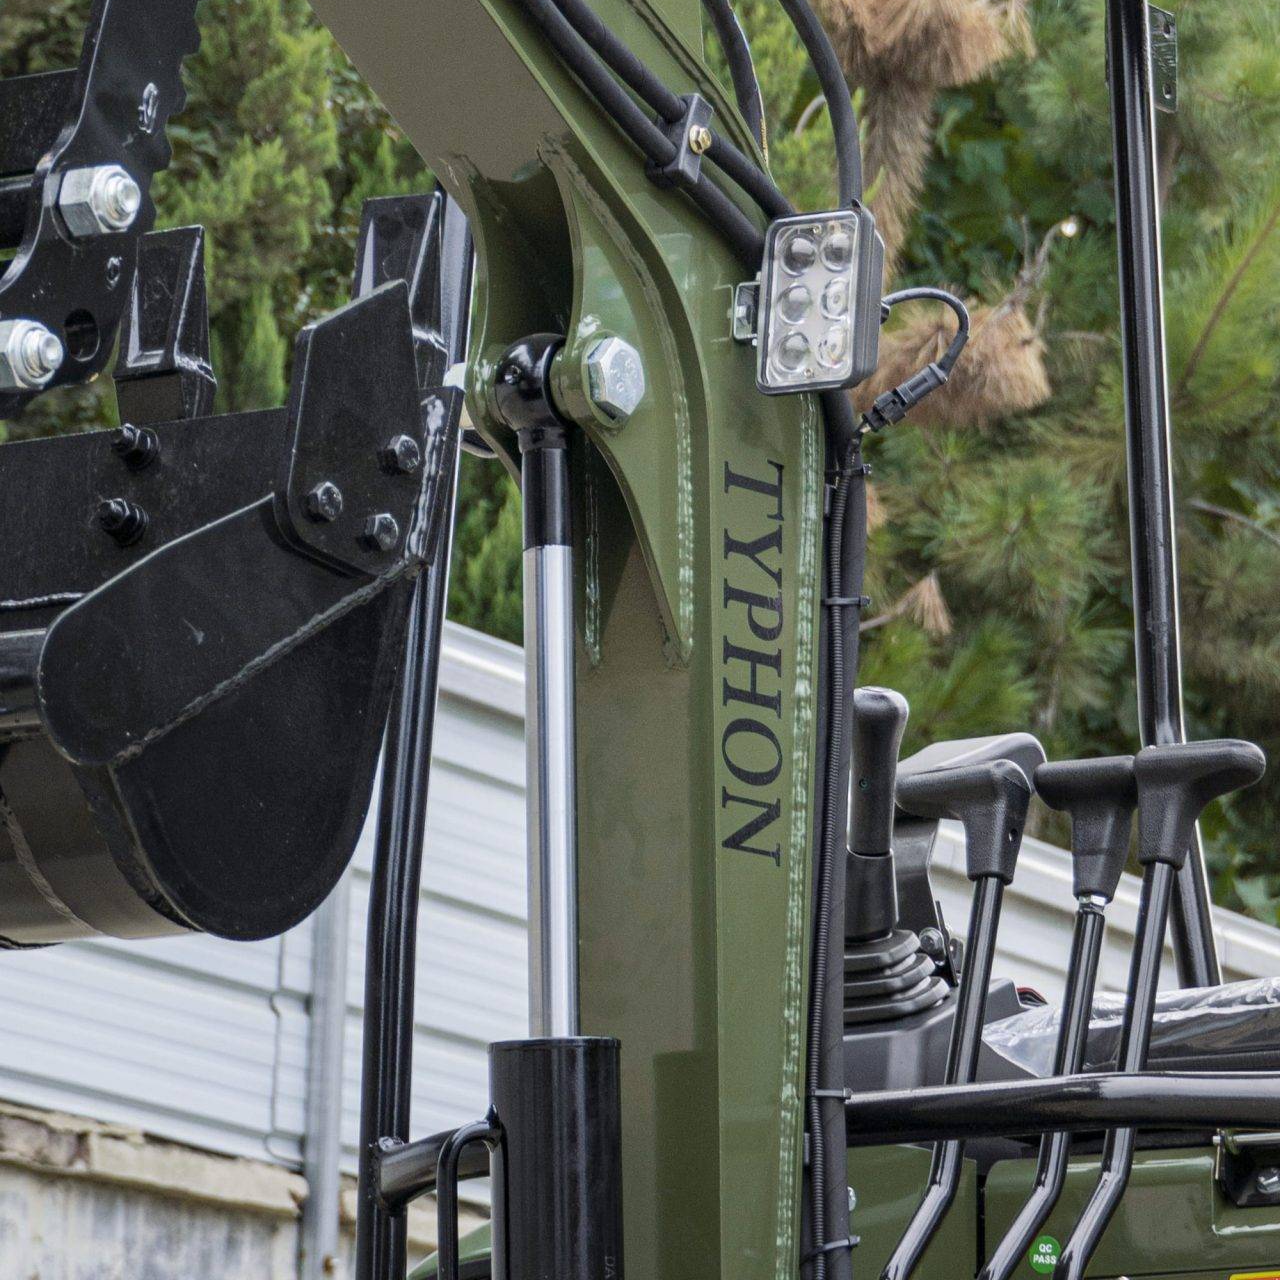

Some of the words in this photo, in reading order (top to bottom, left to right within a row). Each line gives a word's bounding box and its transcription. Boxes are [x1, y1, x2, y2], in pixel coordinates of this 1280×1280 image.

[722, 458, 785, 867] TYPHON
[1038, 1243, 1053, 1253] QC
[1032, 1254, 1057, 1264] PASS
